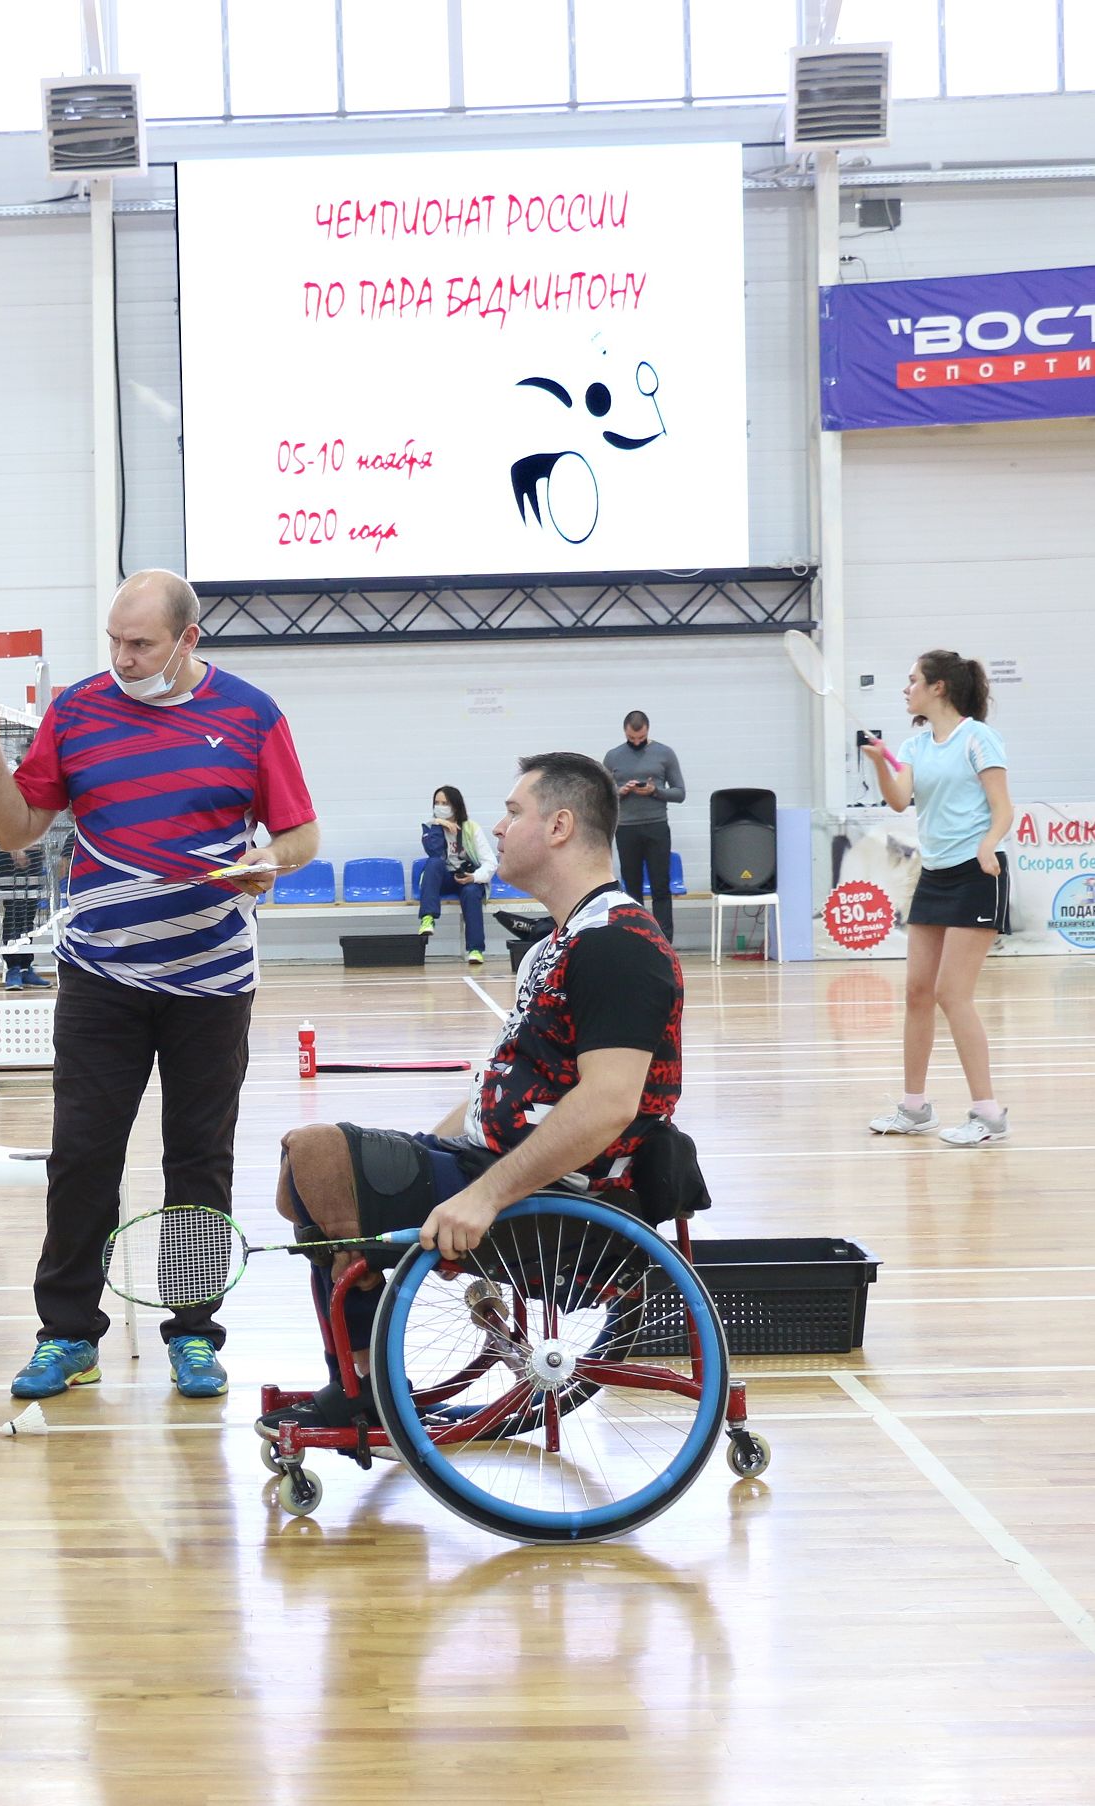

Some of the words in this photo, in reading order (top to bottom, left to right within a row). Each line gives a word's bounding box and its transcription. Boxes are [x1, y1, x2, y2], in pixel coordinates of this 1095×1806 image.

[316, 195, 495, 239] ЧЕМПИОНАТ
[507, 191, 628, 235] РОССИИ
[303, 281, 345, 321] ПО
[359, 277, 432, 318] ПАРА
[446, 272, 646, 328] БАДМИНТОНУ
[277, 439, 344, 475] 05-10
[356, 438, 433, 479] ноября
[277, 508, 337, 545] 2020
[348, 523, 399, 553] года
[1017, 813, 1037, 844] А
[1018, 855, 1074, 873] Скорая
[830, 904, 865, 924] 130
[866, 908, 887, 922] руб.
[838, 892, 873, 904] Всего
